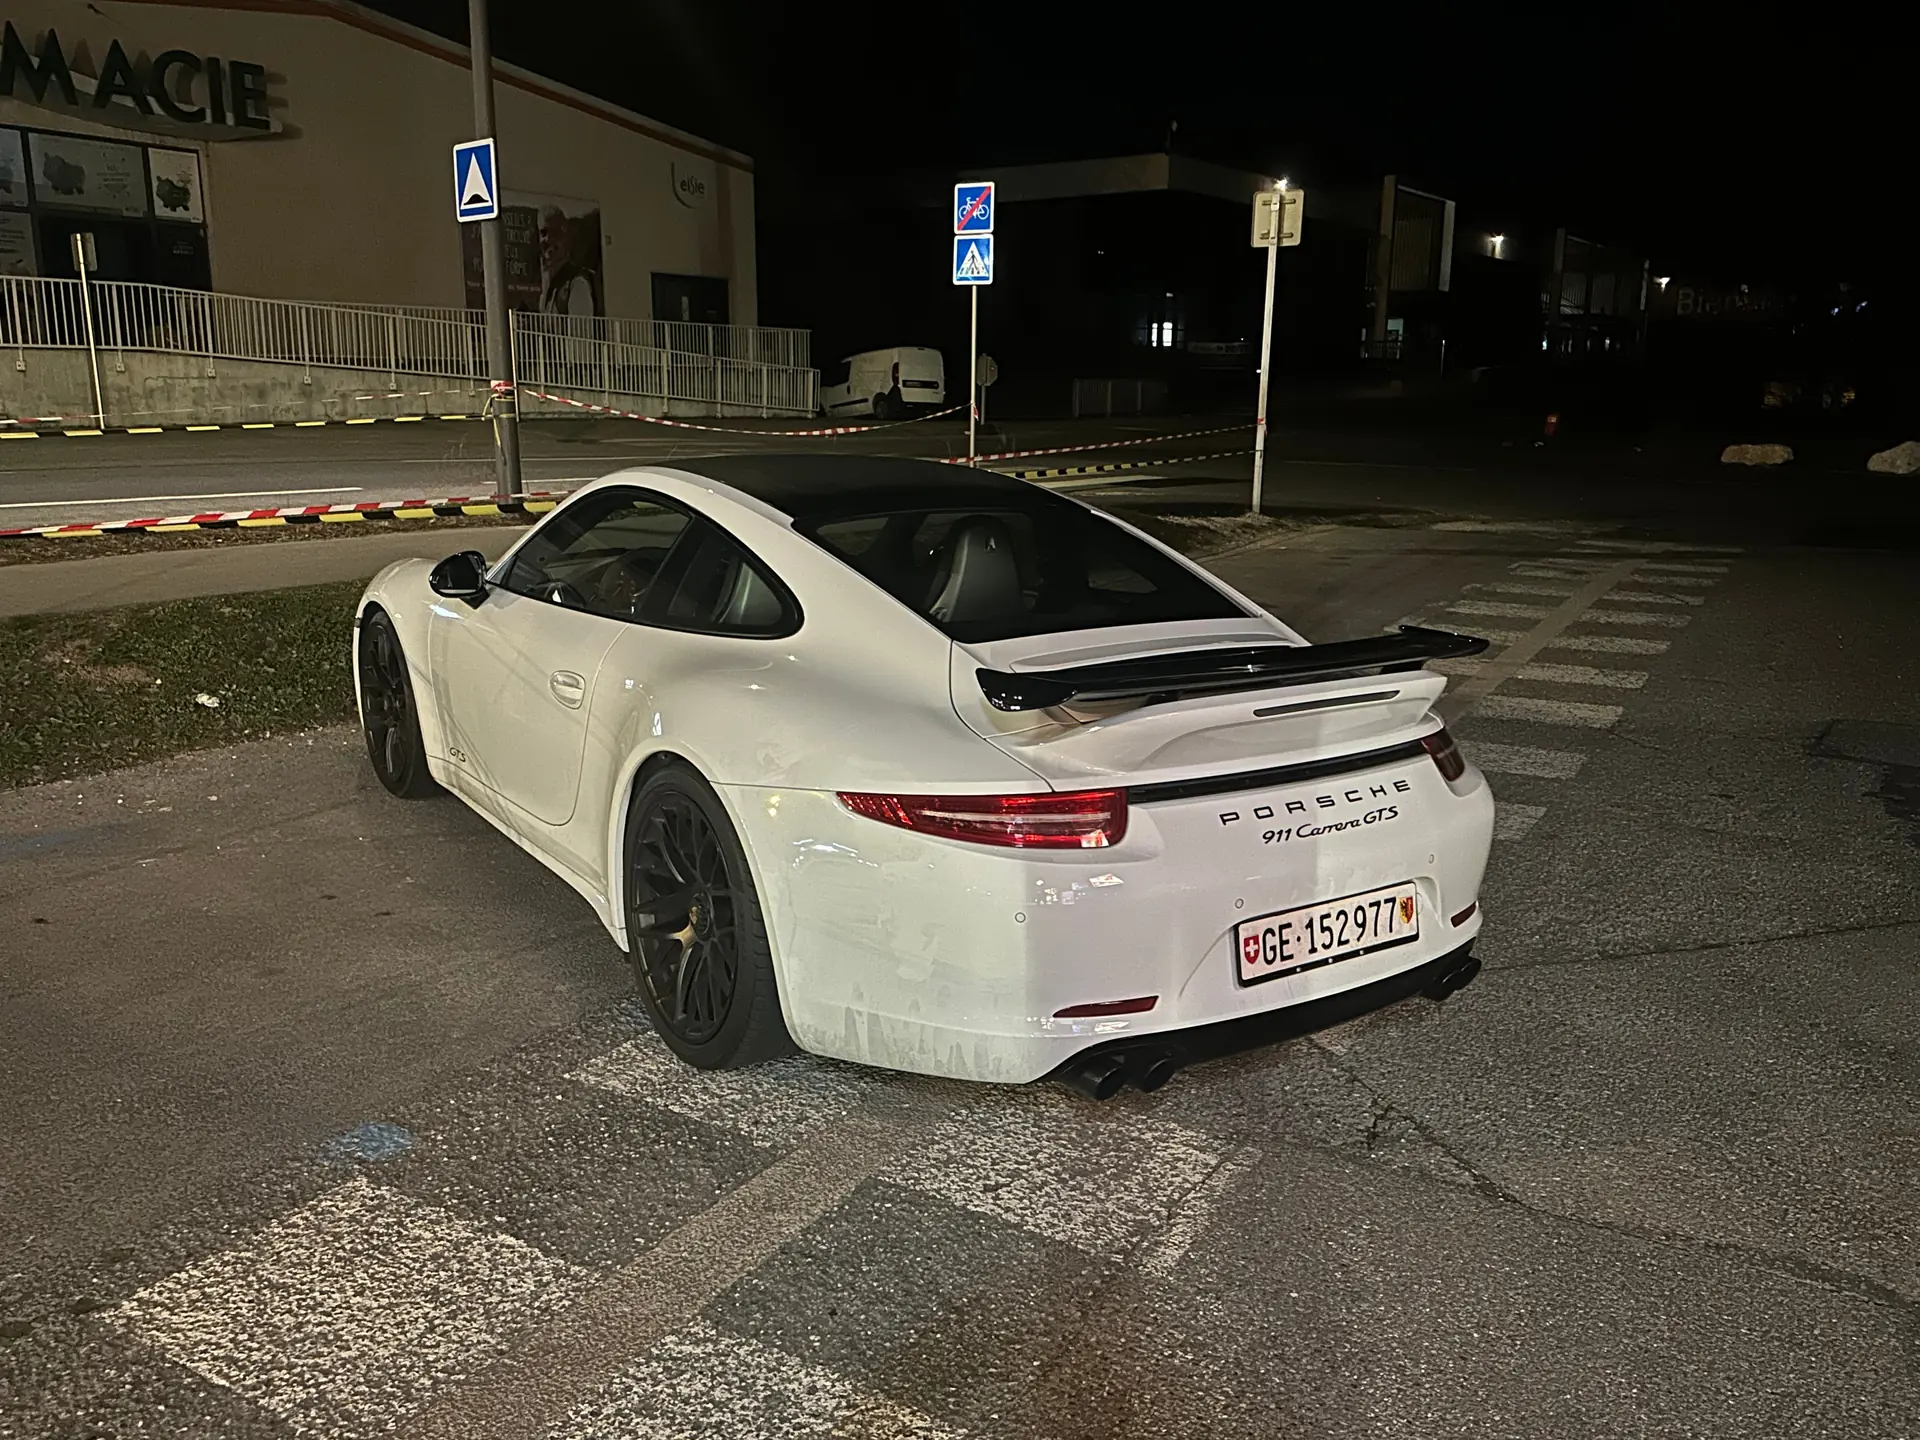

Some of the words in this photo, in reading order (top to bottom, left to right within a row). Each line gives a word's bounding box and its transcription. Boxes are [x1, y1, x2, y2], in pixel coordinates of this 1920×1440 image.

[0, 20, 271, 131] MACIE
[449, 747, 466, 762] GTS
[1219, 779, 1411, 826] PORSCHE
[1262, 828, 1292, 844] 911
[1296, 818, 1361, 838] Carrera
[1363, 805, 1399, 825] GTS
